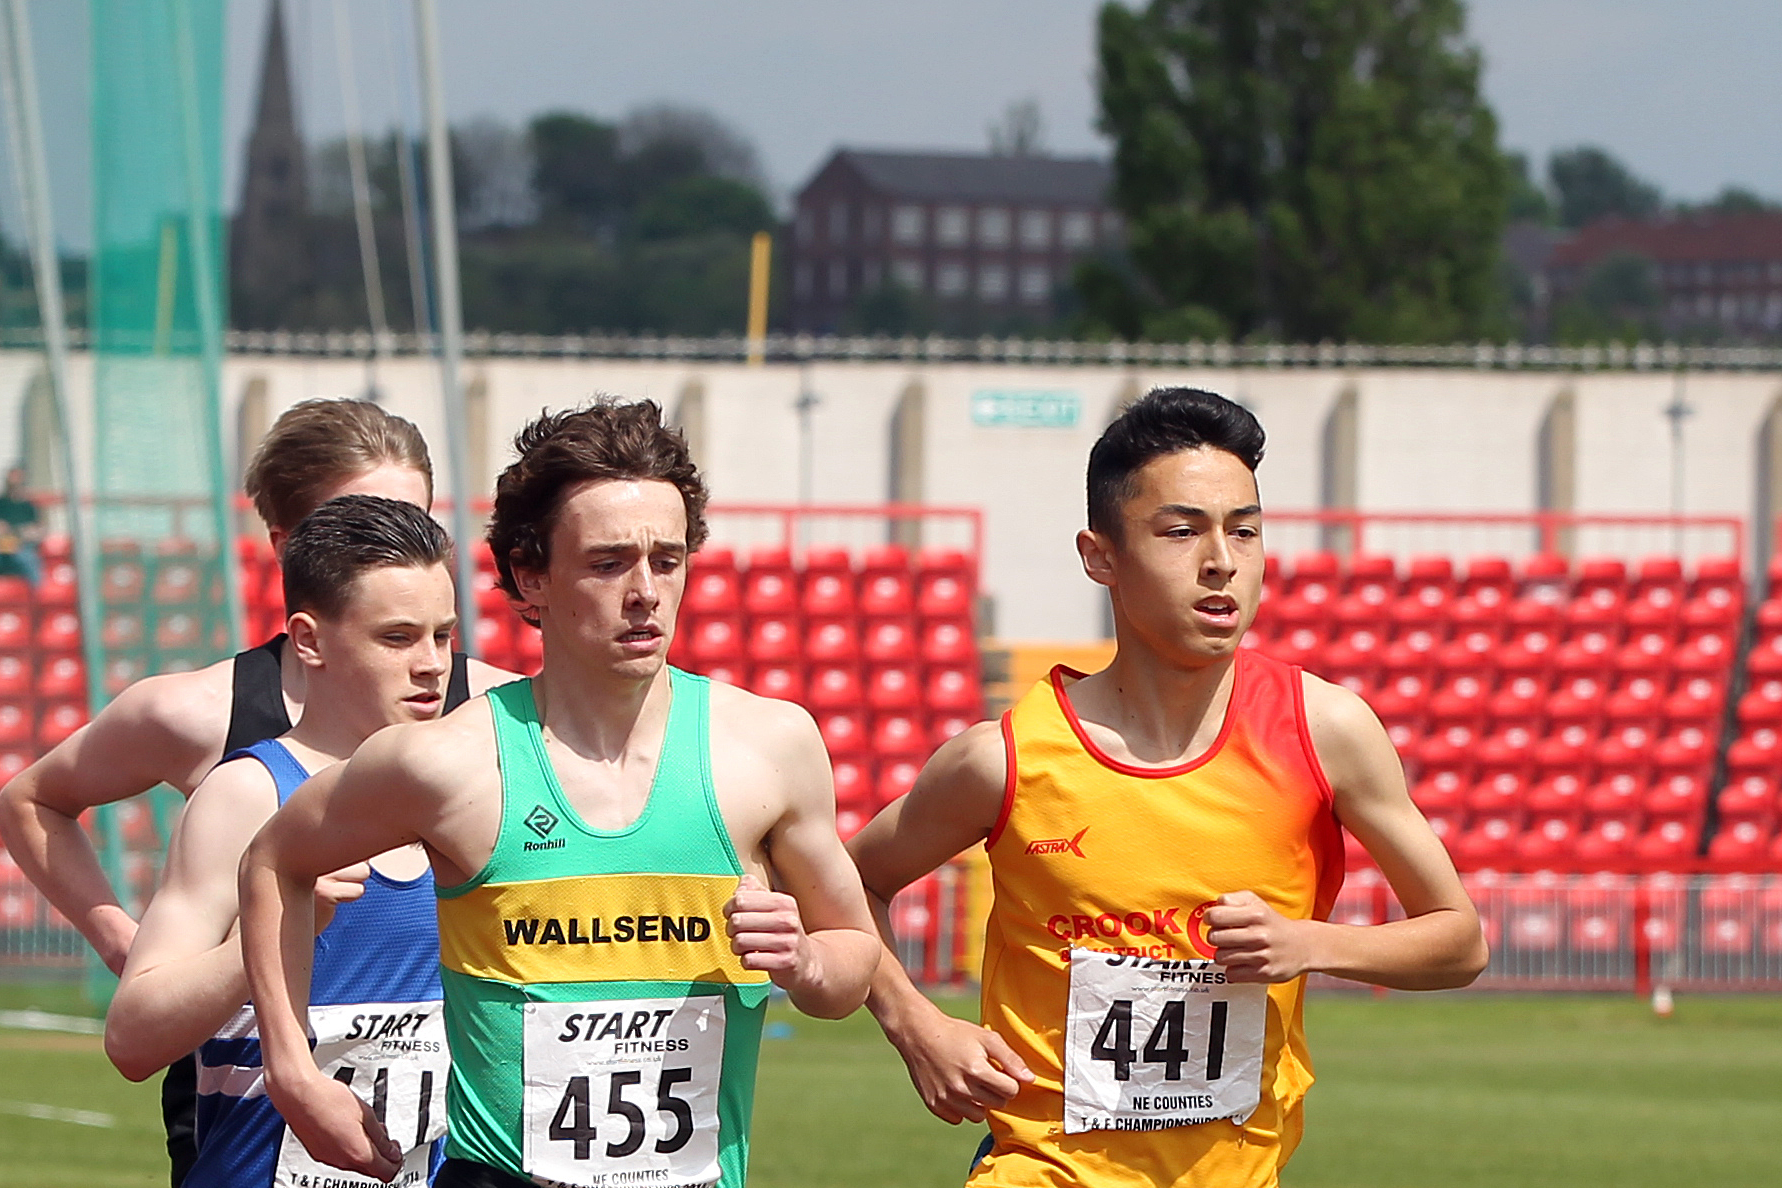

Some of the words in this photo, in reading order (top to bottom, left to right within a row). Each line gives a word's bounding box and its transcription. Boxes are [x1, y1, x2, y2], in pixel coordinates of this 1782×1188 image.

[523, 838, 566, 852] Ronhill
[1024, 825, 1092, 859] FASTRAX
[503, 915, 711, 946] WALLSEND
[1047, 907, 1183, 941] CROOK
[1160, 972, 1233, 984] FITNES
[345, 1014, 430, 1041] START
[557, 1009, 674, 1042] START
[381, 1040, 440, 1052] FITNESS
[614, 1038, 689, 1054] FITNESS
[1091, 1000, 1228, 1082] 441
[1133, 1096, 1150, 1110] NE
[1153, 1095, 1213, 1110] COUNTIES
[548, 1066, 695, 1160] 455
[1081, 1117, 1087, 1130] T
[1092, 1118, 1099, 1130] &
[291, 1173, 298, 1185] T
[301, 1175, 309, 1187] &
[312, 1176, 320, 1188] F
[611, 1168, 669, 1185] COUNTIES
